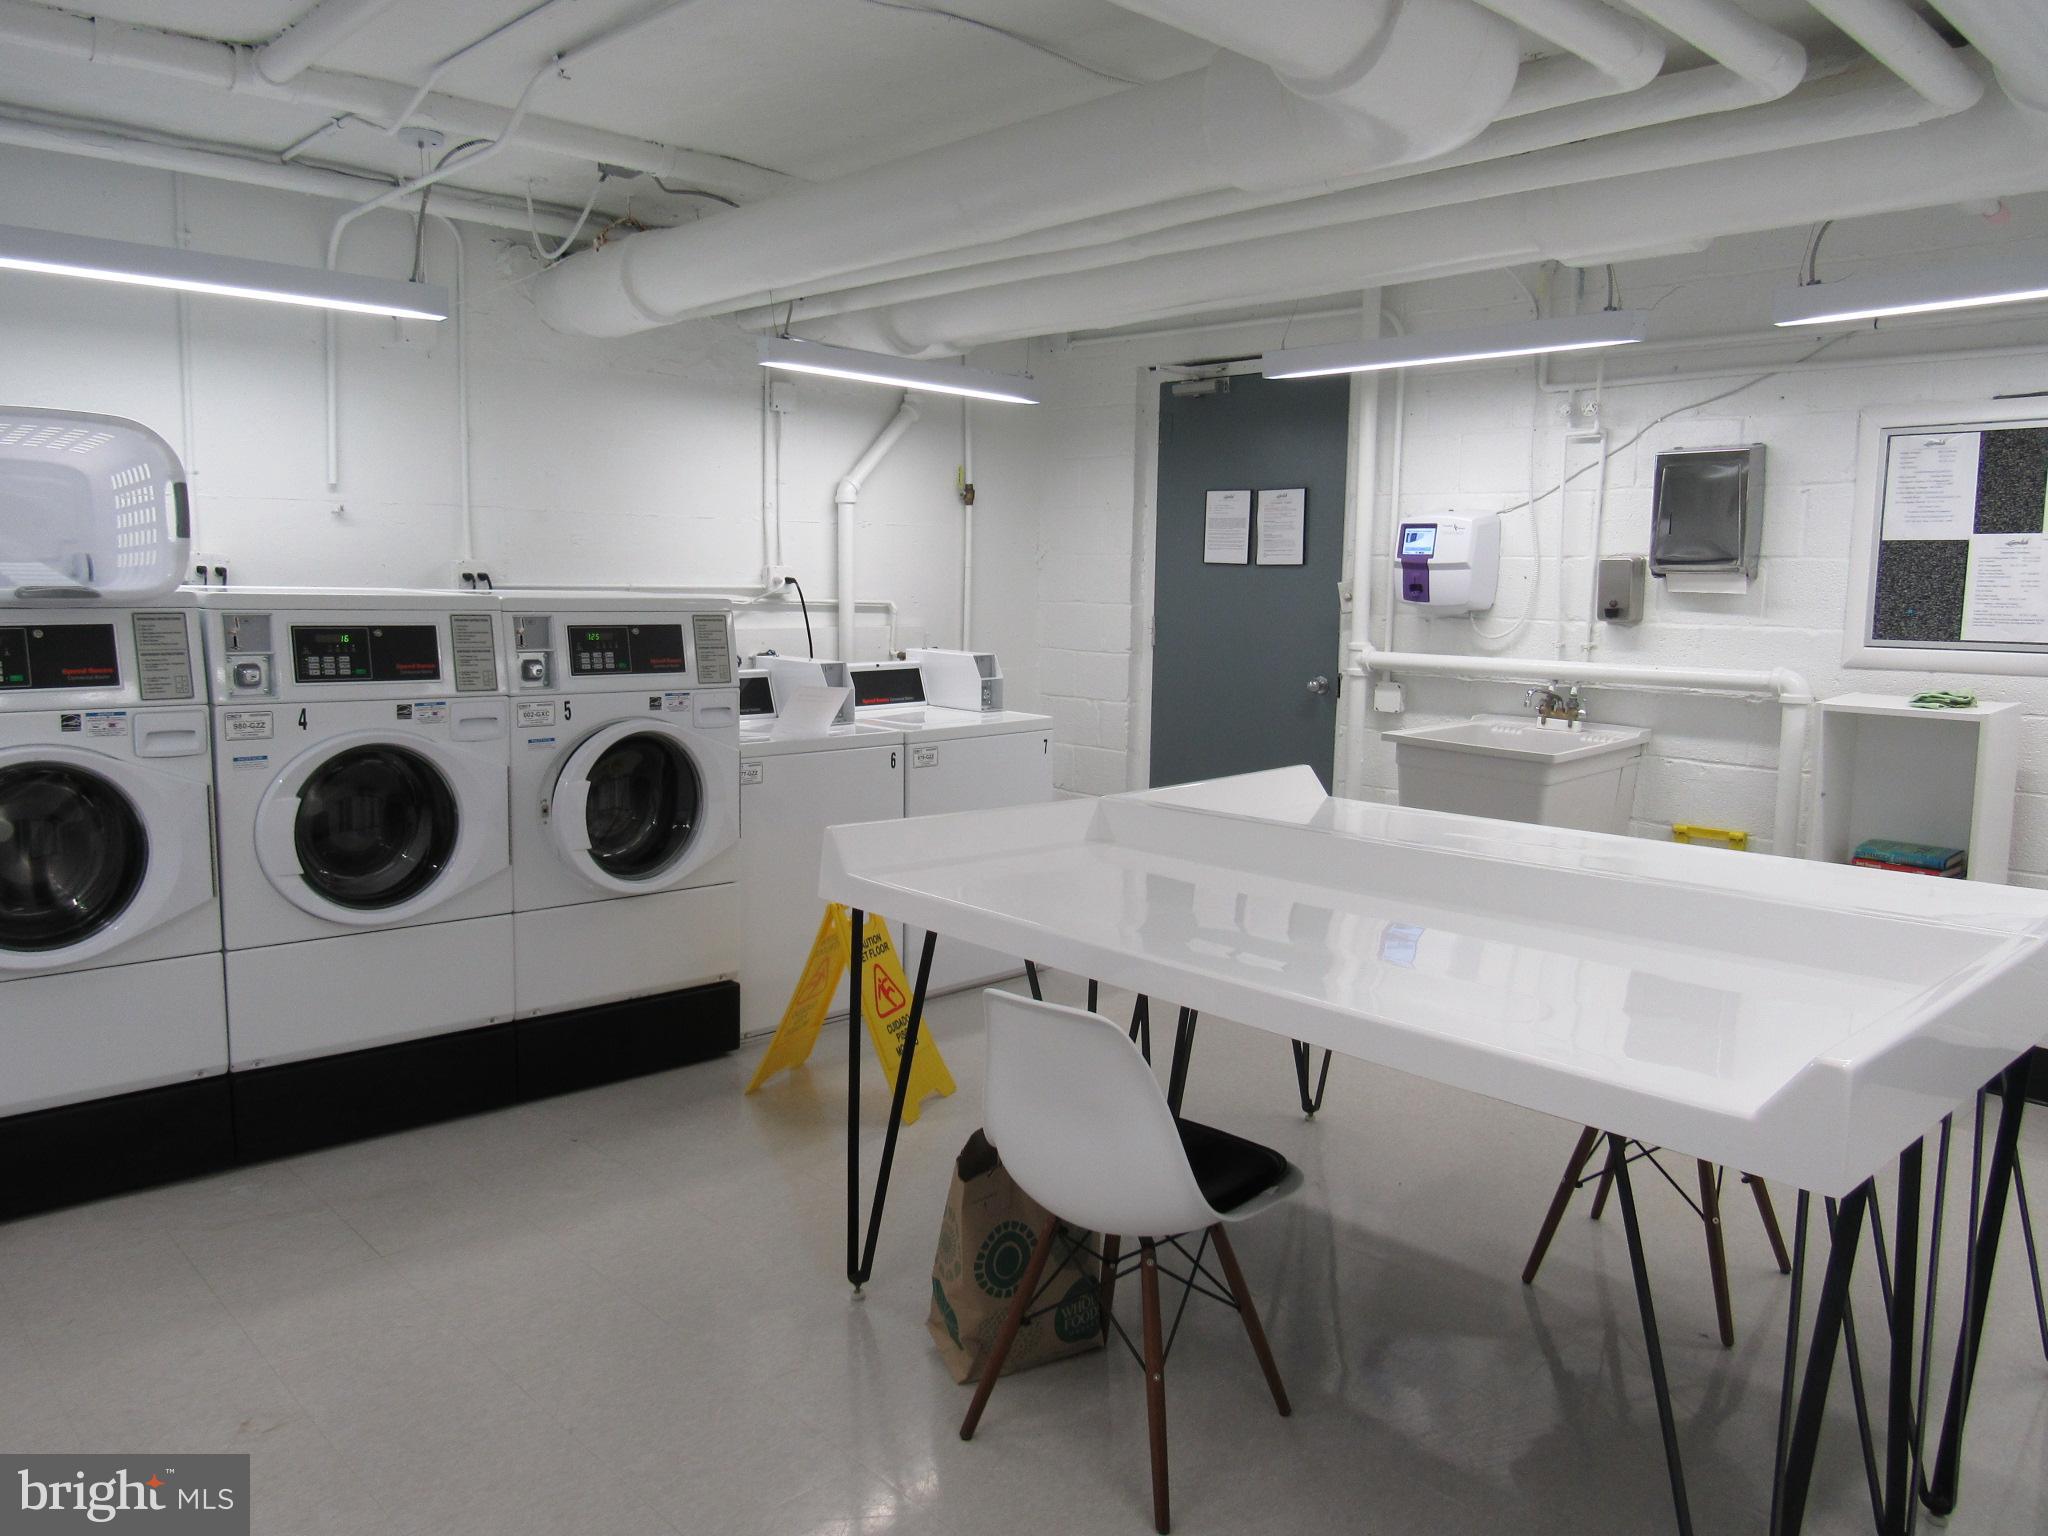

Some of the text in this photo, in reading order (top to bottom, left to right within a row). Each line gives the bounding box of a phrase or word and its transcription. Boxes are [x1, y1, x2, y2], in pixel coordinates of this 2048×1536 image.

[298, 707, 308, 731] 4
[564, 700, 572, 721] 5
[1043, 738, 1048, 755] 7
[890, 752, 896, 769] 6
[868, 942, 890, 959] FLOOR
